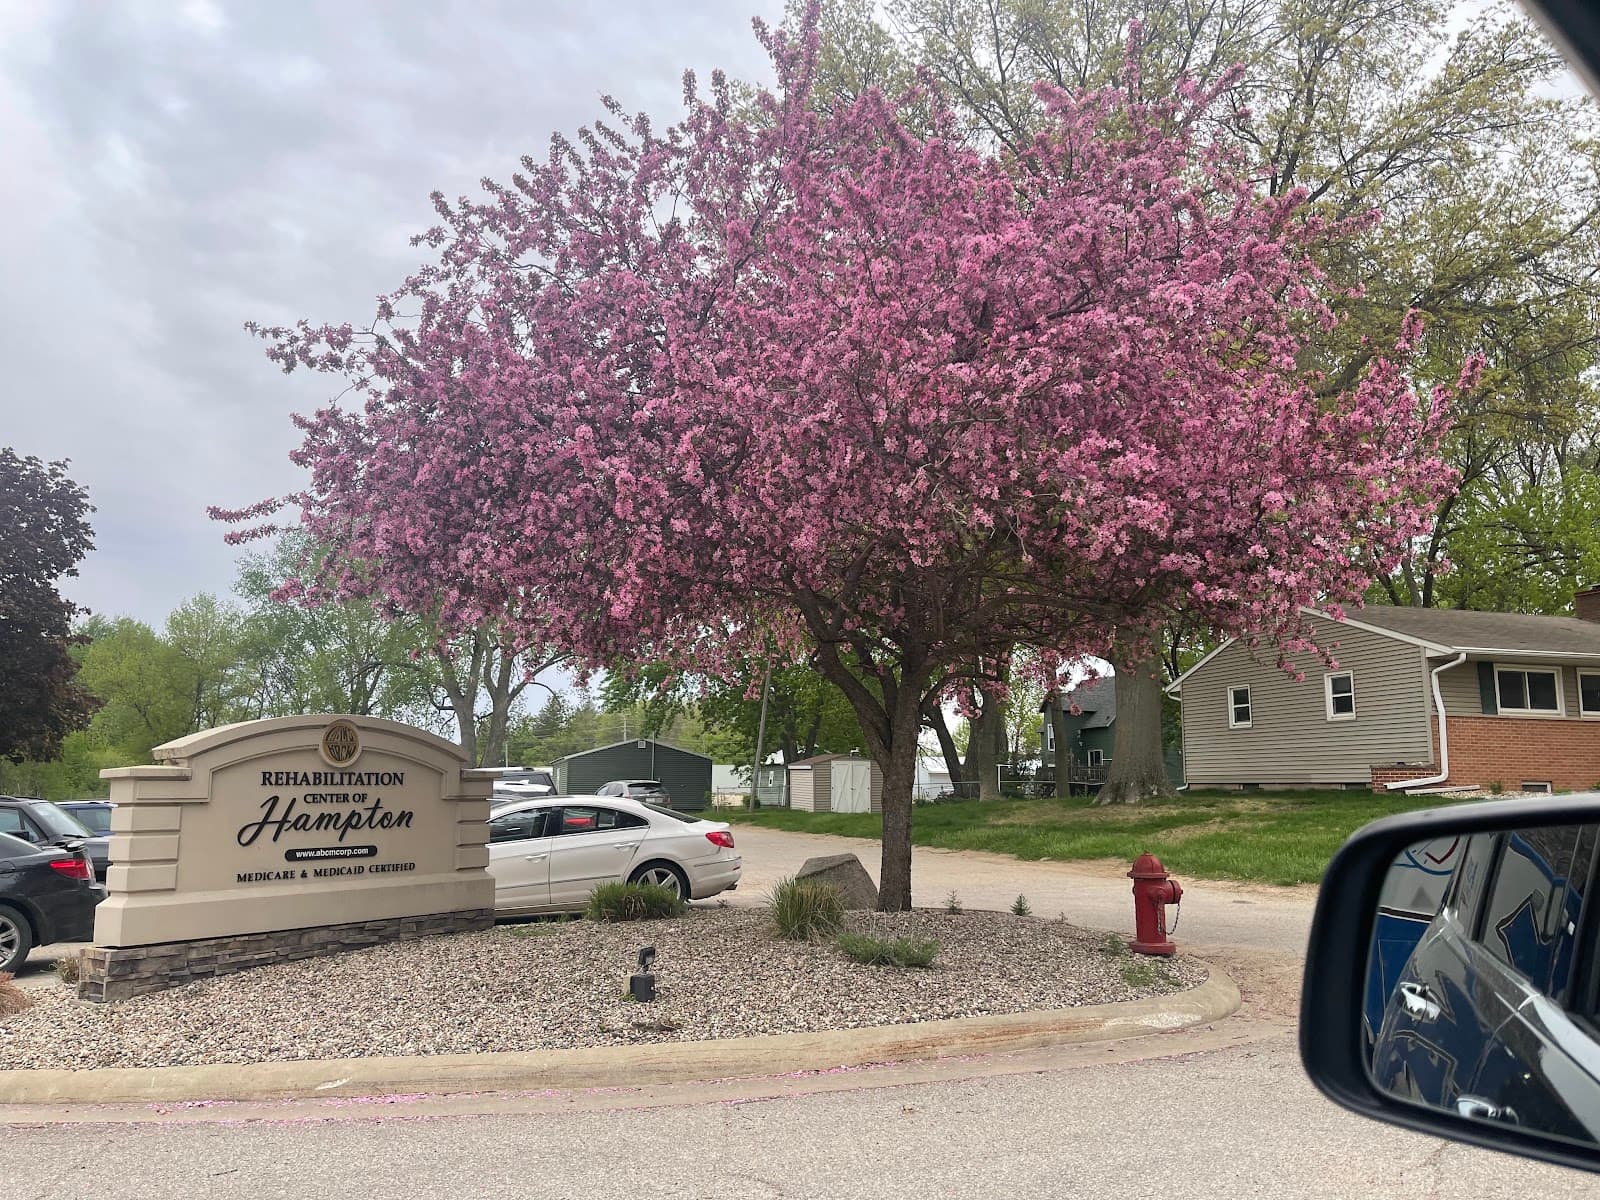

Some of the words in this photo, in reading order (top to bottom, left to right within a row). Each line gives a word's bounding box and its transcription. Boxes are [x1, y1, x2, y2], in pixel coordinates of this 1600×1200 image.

[261, 772, 405, 786] REHABILITATION
[303, 793, 349, 804] CENTER
[352, 793, 368, 803] OF
[237, 795, 413, 847] Hampton
[295, 848, 369, 858] www.abcmcorp.com
[236, 870, 296, 883] MEDICARE
[300, 869, 308, 878] &
[313, 866, 365, 878] MEDICAID
[368, 862, 416, 873] CERTIFIED
